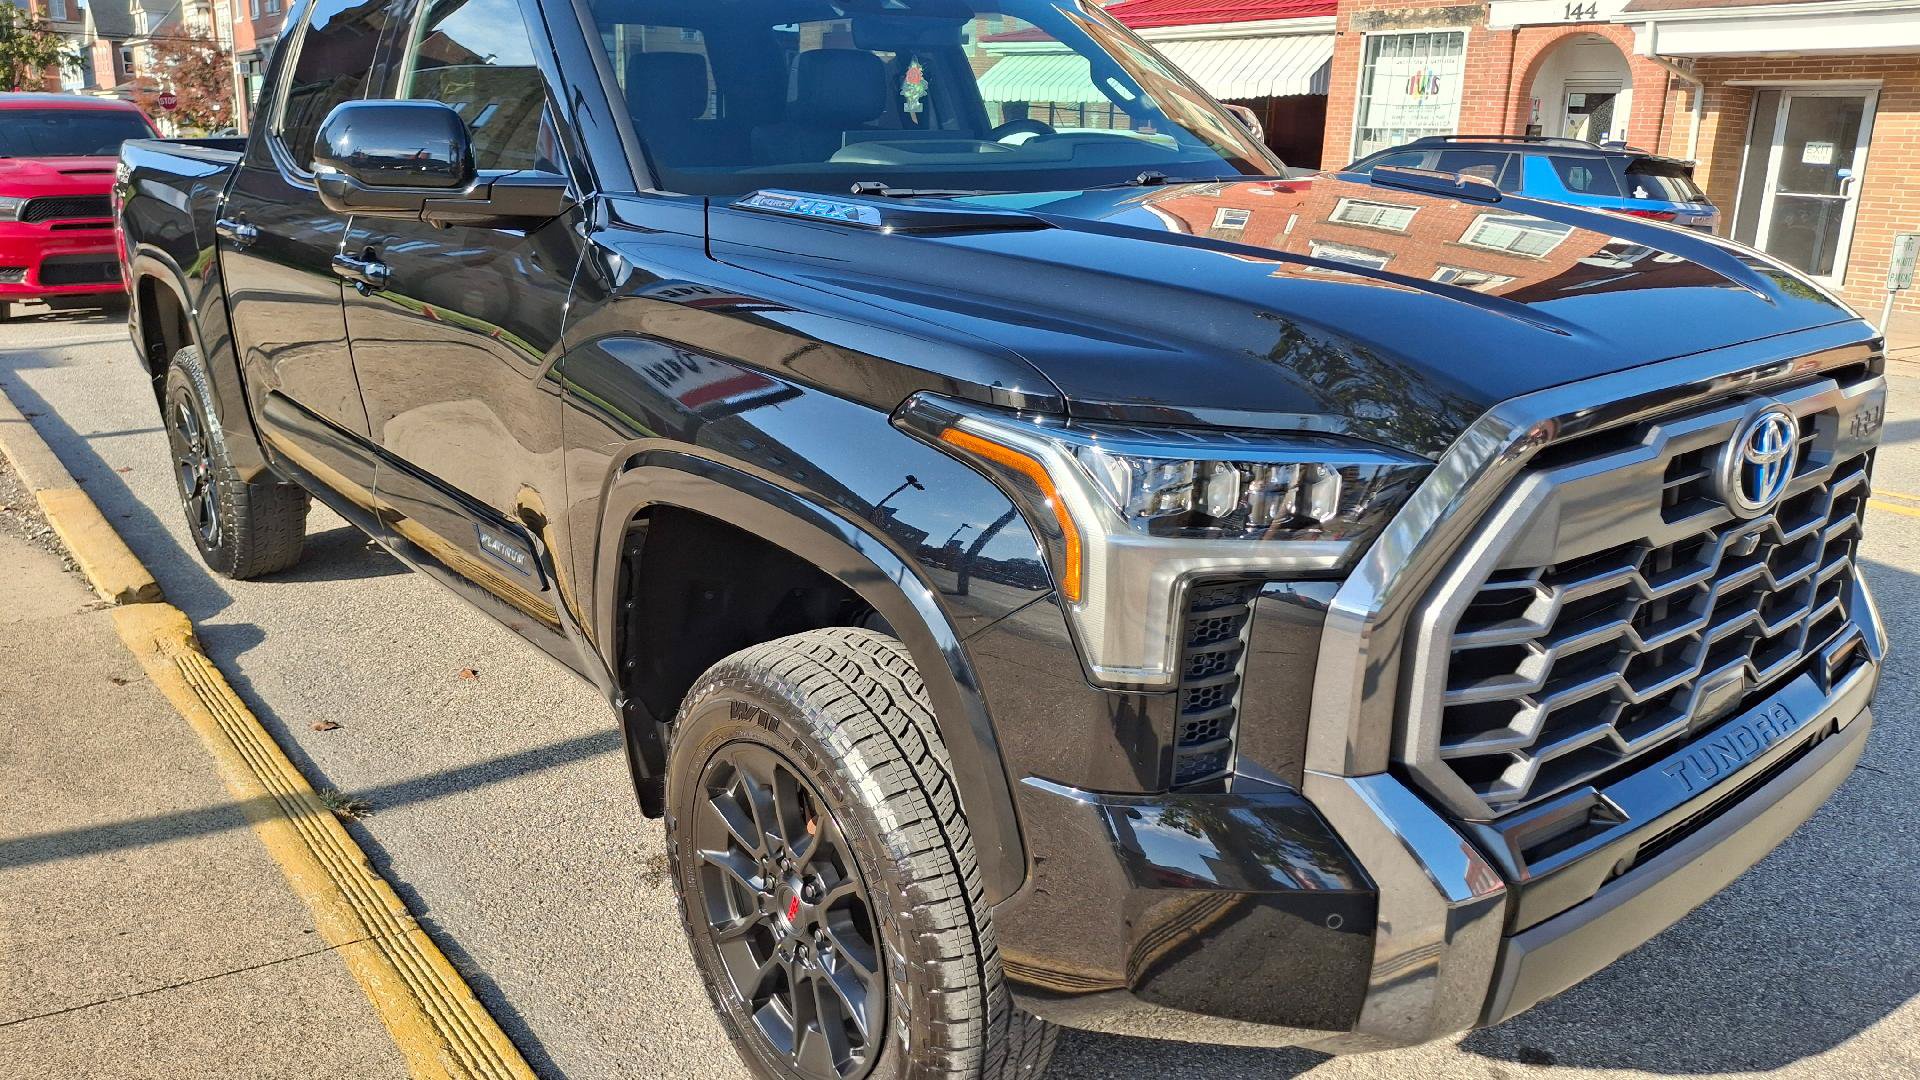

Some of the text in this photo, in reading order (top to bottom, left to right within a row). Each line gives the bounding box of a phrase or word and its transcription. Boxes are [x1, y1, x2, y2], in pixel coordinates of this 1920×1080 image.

[1563, 1, 1598, 20] 144
[159, 96, 177, 105] STOP
[1806, 144, 1832, 154] EXIT
[480, 532, 526, 566] PLATINUM
[1661, 701, 1797, 792] TUNDRA
